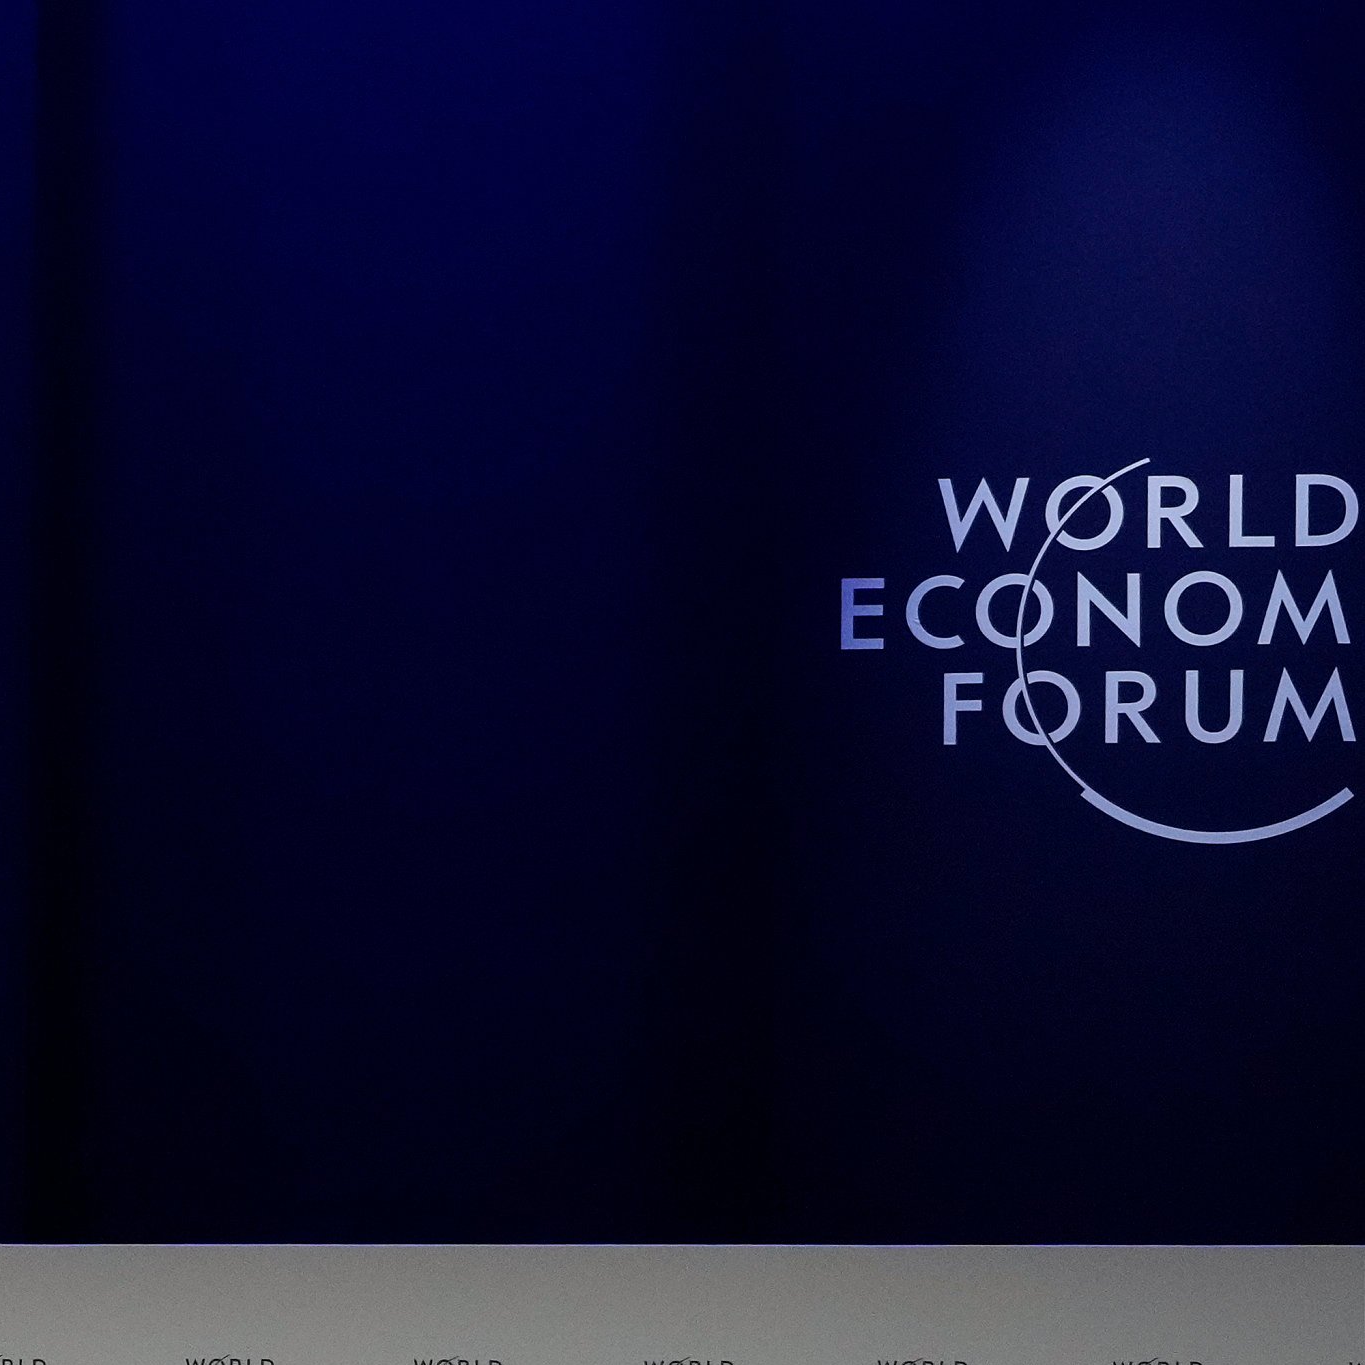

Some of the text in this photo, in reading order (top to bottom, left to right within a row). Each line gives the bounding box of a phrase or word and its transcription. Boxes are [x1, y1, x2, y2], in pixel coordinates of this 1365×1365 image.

[937, 474, 1359, 553] WORLD
[840, 569, 1351, 650] ECONOM
[943, 667, 1356, 746] FORUM
